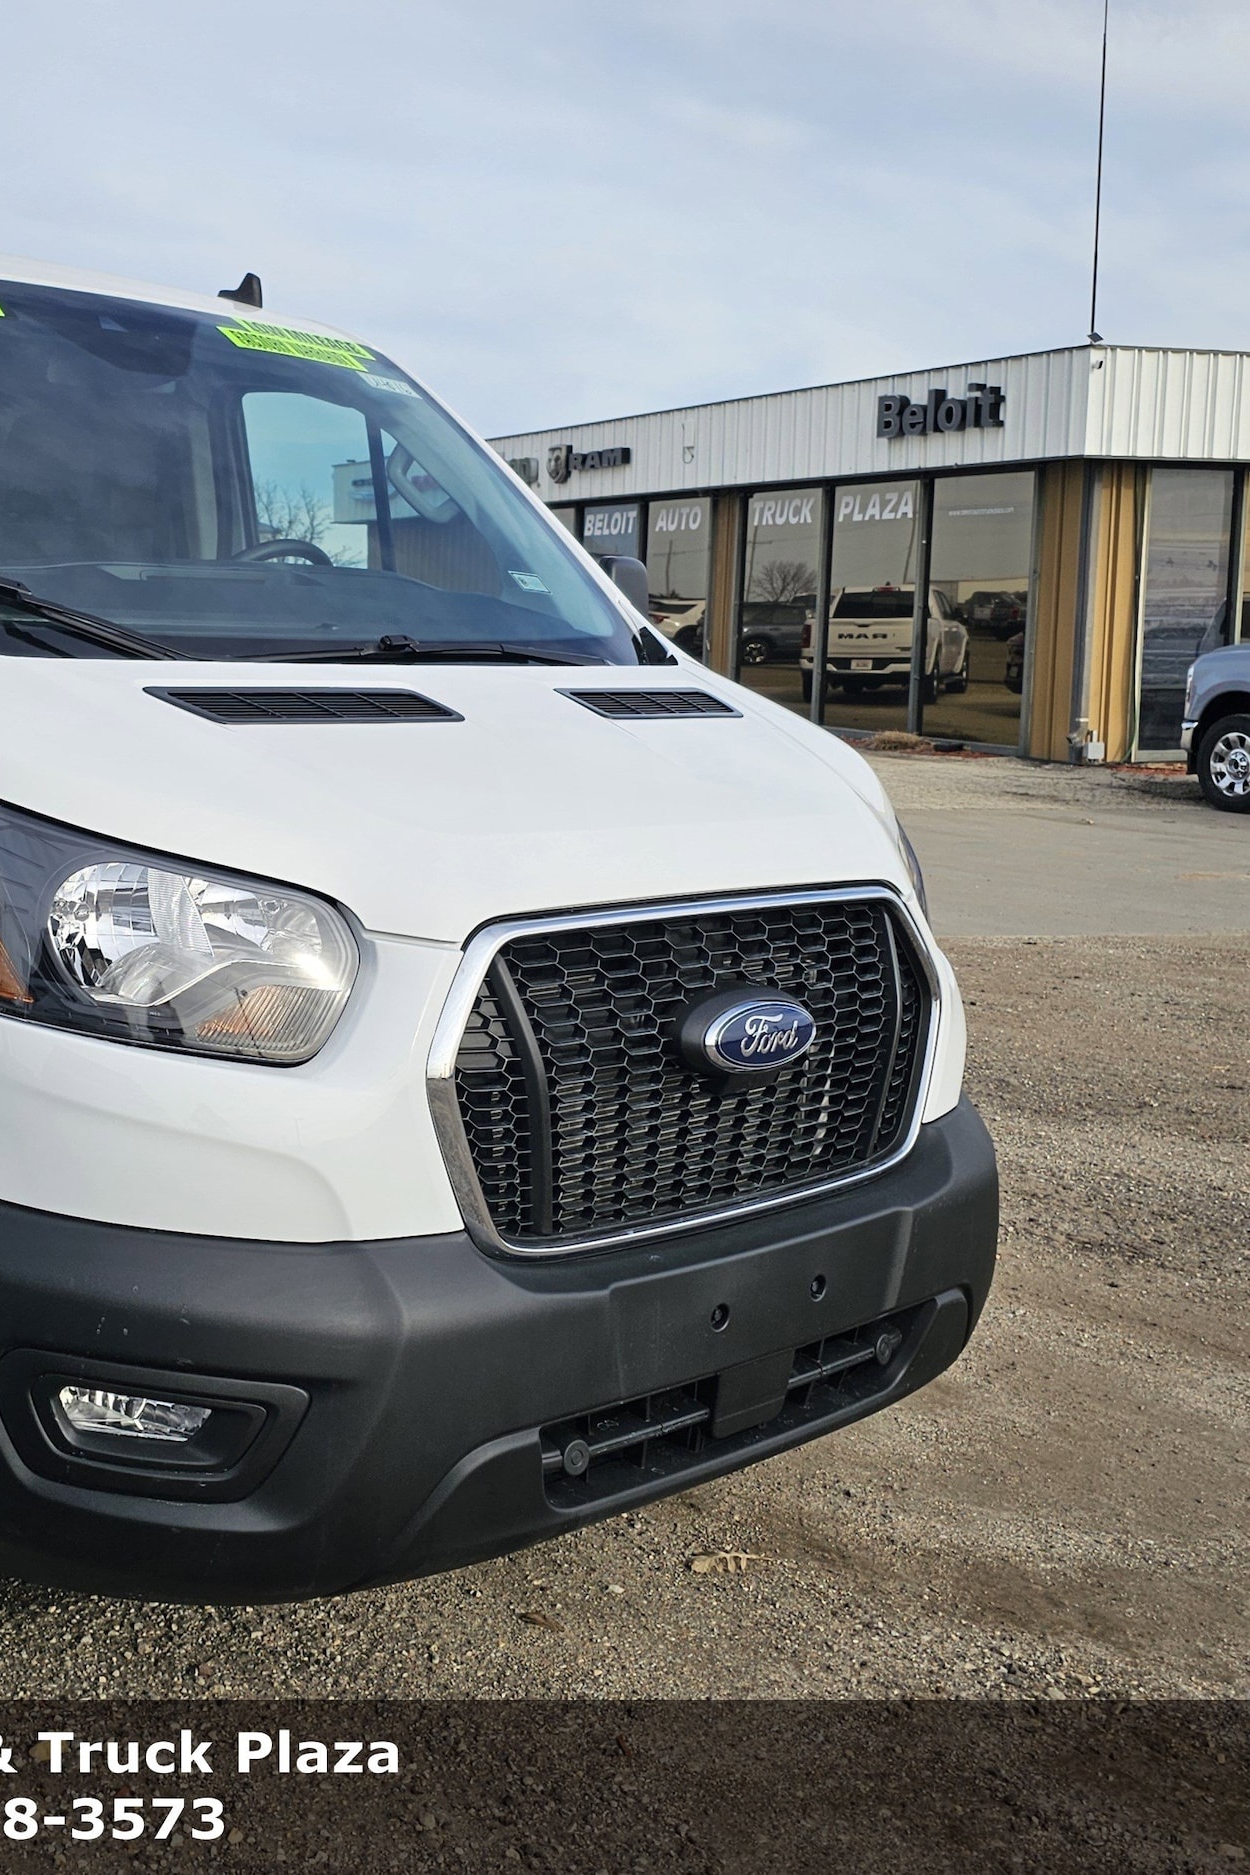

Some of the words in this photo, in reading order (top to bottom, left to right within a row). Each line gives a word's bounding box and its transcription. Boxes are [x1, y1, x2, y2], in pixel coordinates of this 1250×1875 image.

[876, 383, 1007, 439] Beloit
[568, 447, 631, 472] RAM
[584, 510, 638, 536] BELOIT
[655, 506, 702, 532] AUTO
[753, 496, 816, 527] TRUCK
[838, 491, 914, 523] PLAZA
[740, 1013, 799, 1058] Ford
